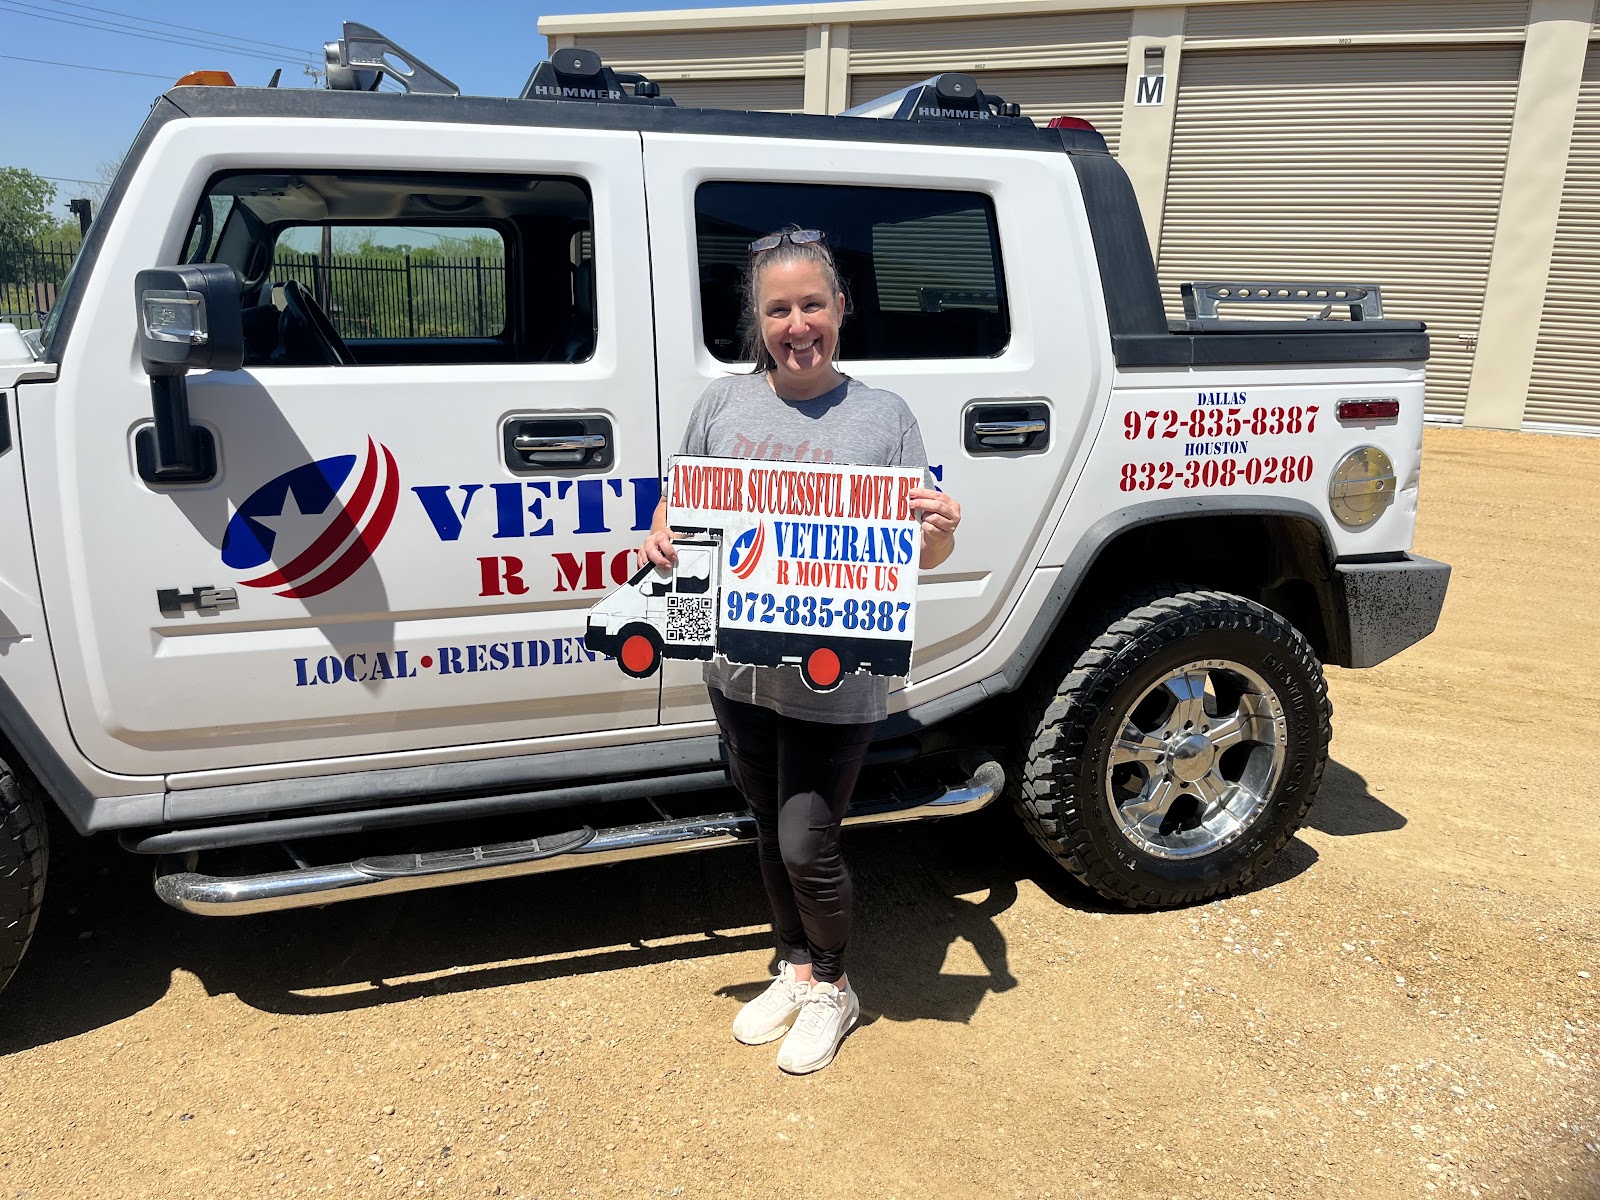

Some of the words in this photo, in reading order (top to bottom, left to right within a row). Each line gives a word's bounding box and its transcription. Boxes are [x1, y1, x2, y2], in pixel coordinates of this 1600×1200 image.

[535, 85, 622, 100] HUMMER
[1137, 76, 1164, 104] M
[918, 106, 990, 120] HUMMER
[1197, 391, 1247, 406] DALLAS
[1123, 405, 1321, 441] 972-835-8387
[1184, 440, 1249, 457] HOUSTON
[1119, 454, 1314, 492] 832-308-0280
[670, 465, 744, 512] ANOTHER
[747, 468, 845, 518] SUCCESSFUL
[849, 474, 894, 520] MOVE
[773, 520, 914, 566] VETERANS
[476, 556, 529, 597] R
[776, 559, 789, 585] R
[796, 562, 868, 591] MOVING
[874, 566, 899, 592] US
[726, 590, 912, 633] 972-835-8387
[294, 650, 418, 687] LOCAL
